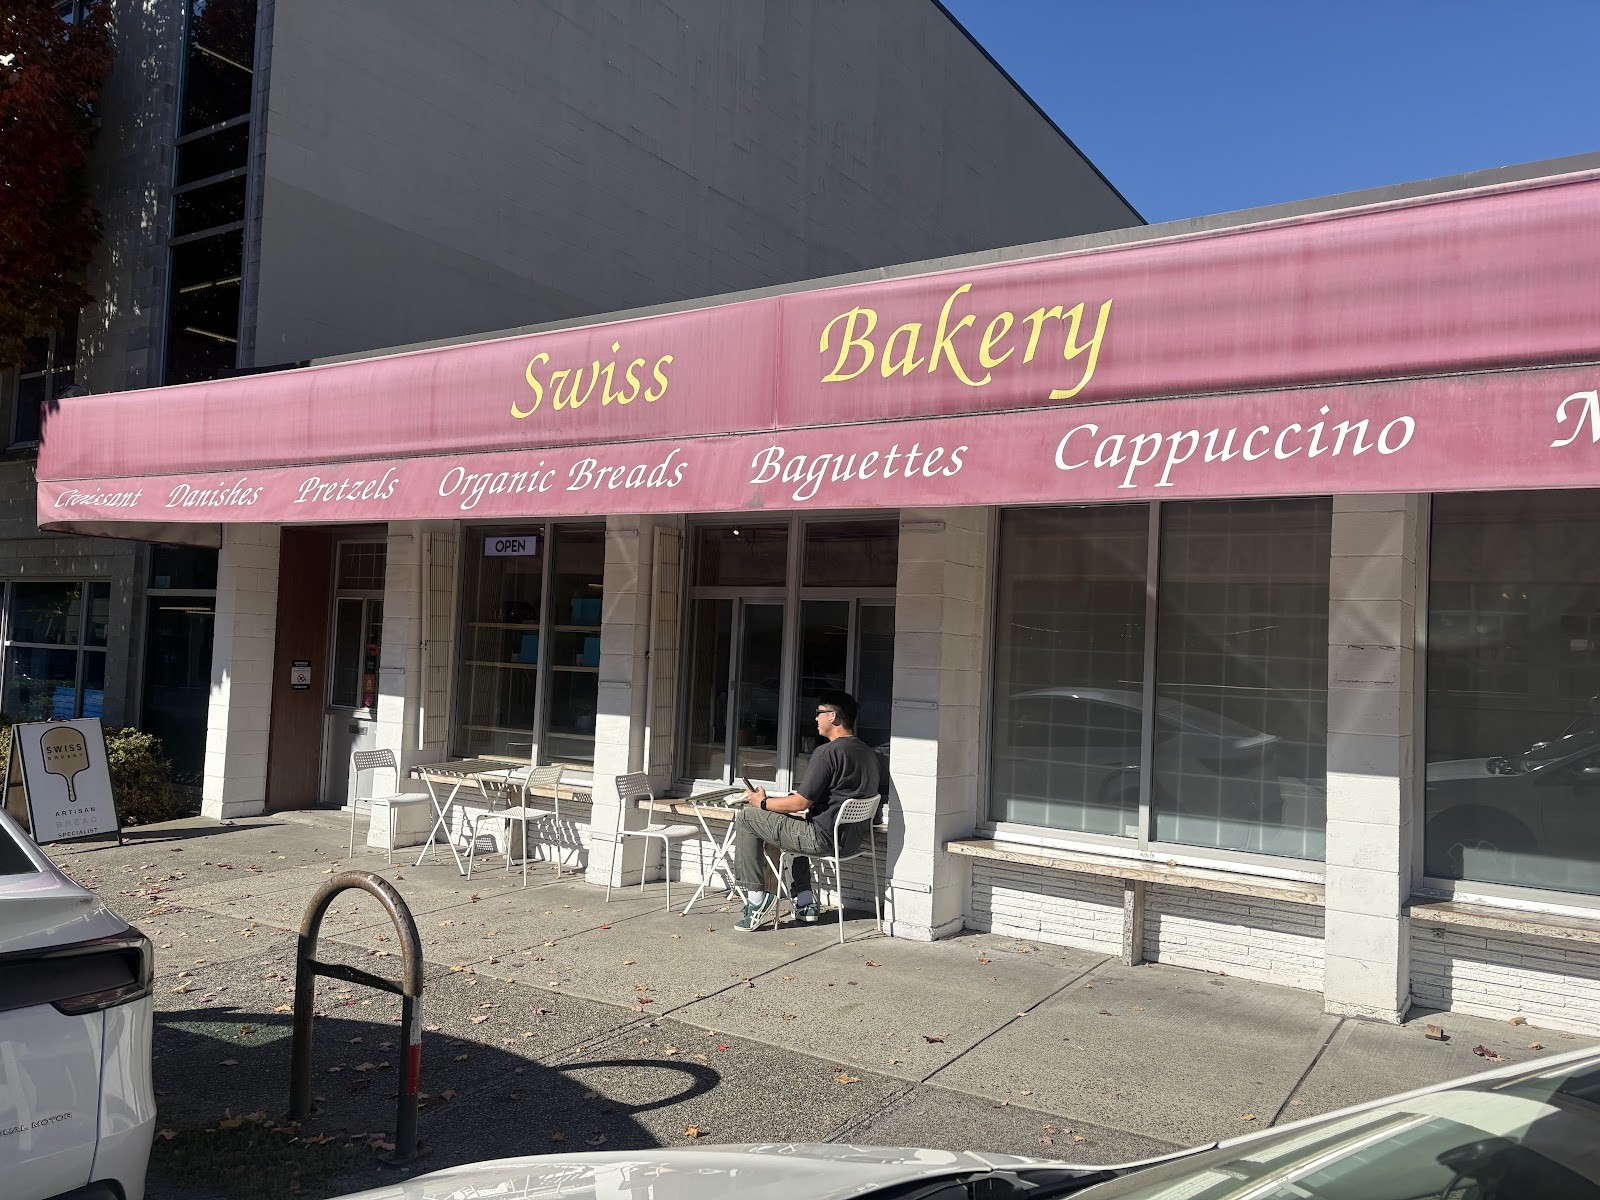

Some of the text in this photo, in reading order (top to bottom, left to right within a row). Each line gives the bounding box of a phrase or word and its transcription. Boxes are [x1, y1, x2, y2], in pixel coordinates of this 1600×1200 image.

[510, 283, 1113, 420] Swiss Bakery
[53, 486, 144, 508] Croissant
[164, 477, 264, 508] Danishes
[293, 466, 400, 504] Pretzels
[438, 460, 556, 511] Organic
[565, 447, 689, 492] Breads
[749, 441, 969, 502] Baguettes
[1054, 404, 1416, 489] Cappuccino
[495, 539, 526, 553] OPEN
[46, 743, 83, 754] SWISS
[55, 806, 96, 817] ARTISAN
[56, 816, 97, 828] BREAD
[57, 827, 98, 838] SPECIALIST
[31, 1112, 73, 1128] MOTOR
